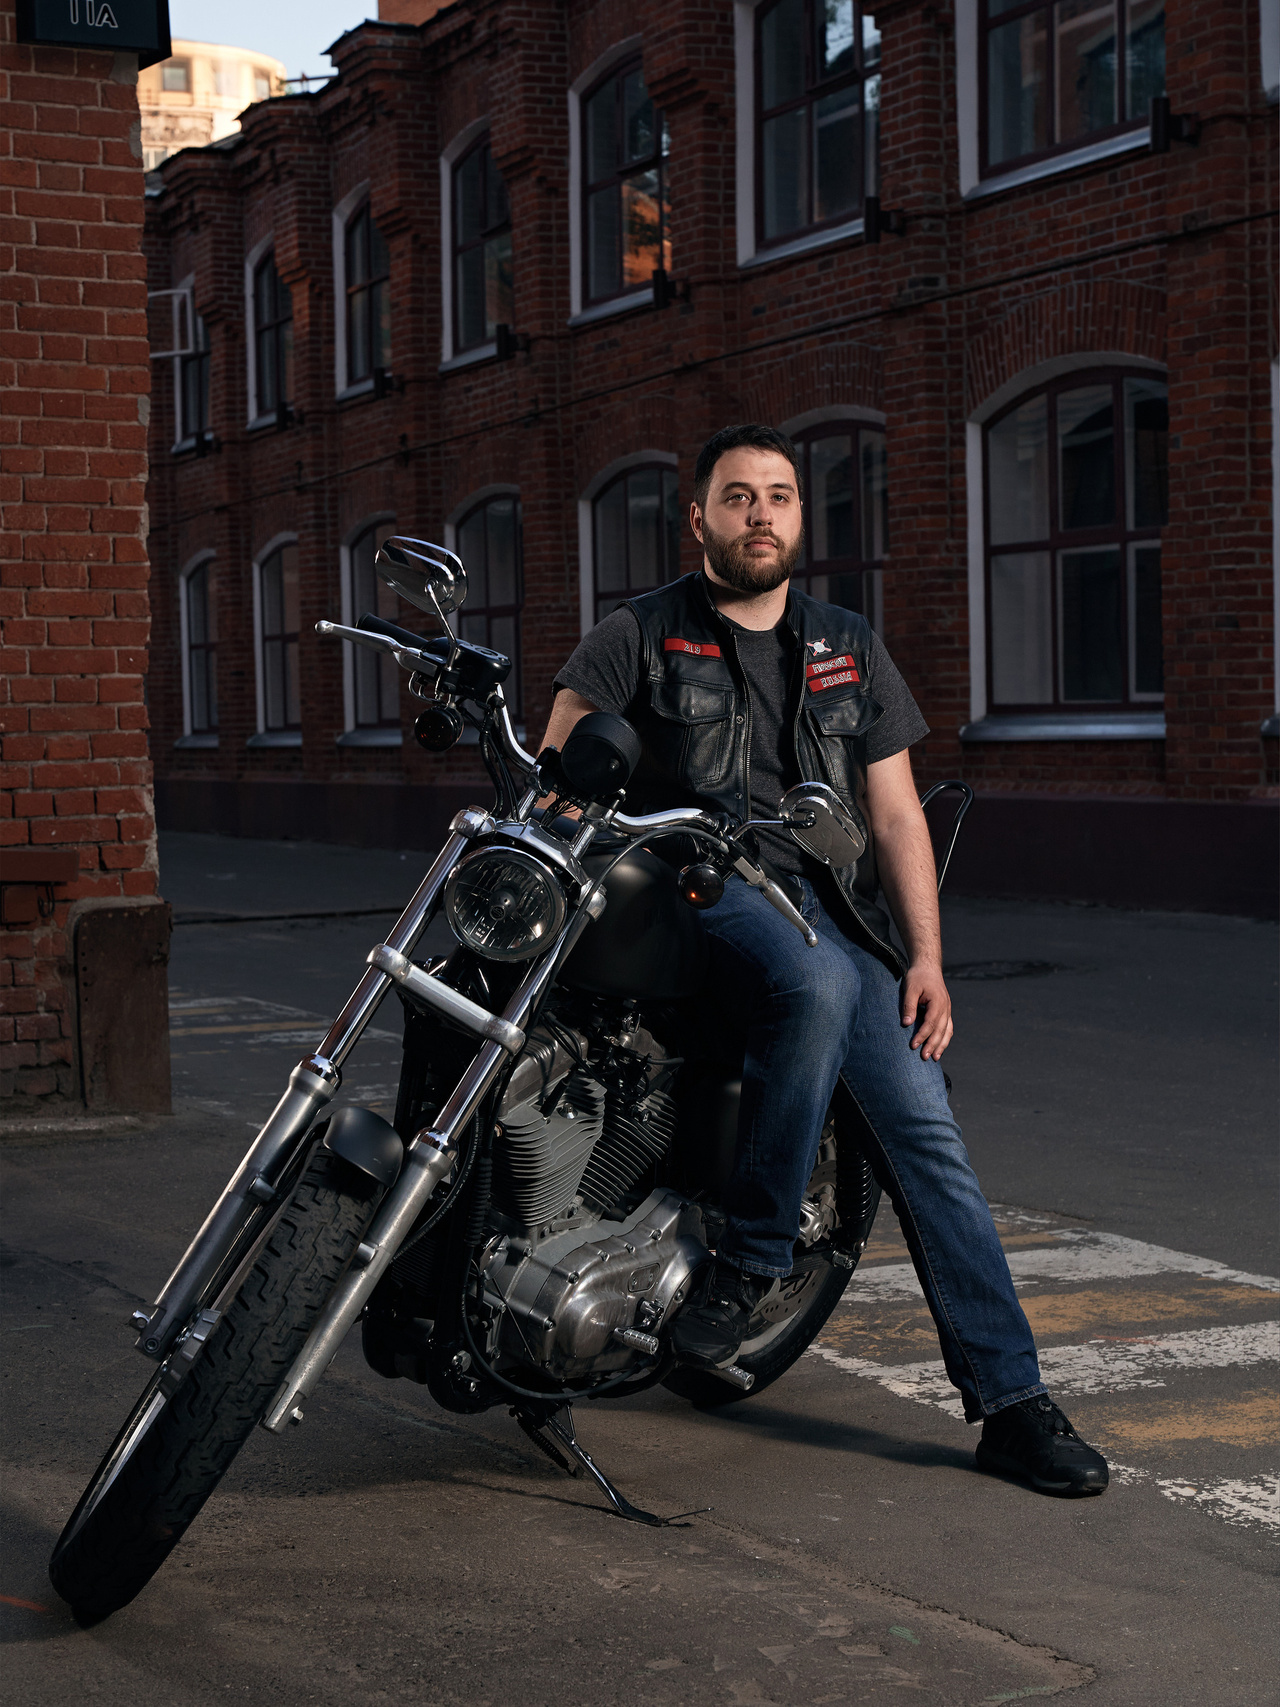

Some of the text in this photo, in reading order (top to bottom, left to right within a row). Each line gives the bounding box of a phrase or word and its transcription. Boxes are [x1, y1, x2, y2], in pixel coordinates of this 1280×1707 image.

[684, 642, 701, 655] 219
[812, 656, 847, 674] MOSCOW
[820, 673, 853, 688] RUSSIA
